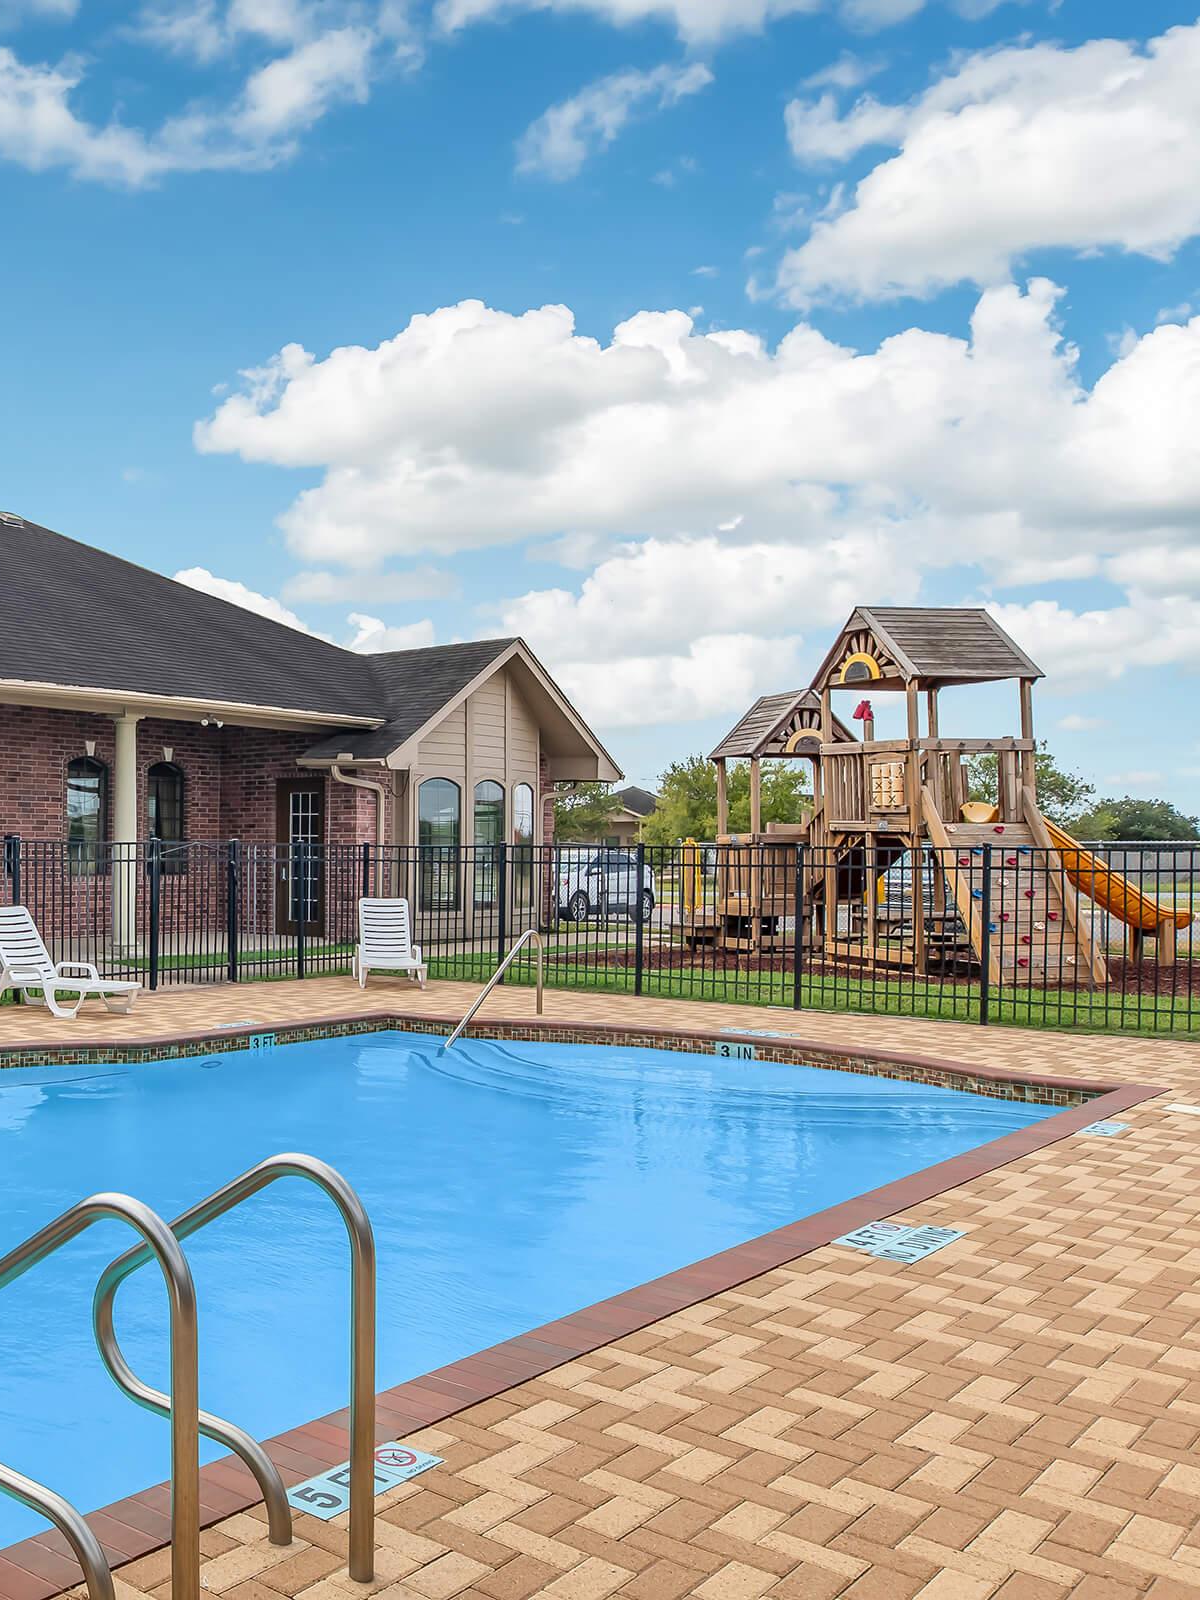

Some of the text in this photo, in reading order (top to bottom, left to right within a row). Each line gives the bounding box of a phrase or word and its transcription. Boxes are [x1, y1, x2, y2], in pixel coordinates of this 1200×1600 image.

[253, 1035, 274, 1049] 3 FT
[721, 1044, 752, 1060] 3 IN
[291, 1487, 342, 1508] 5
